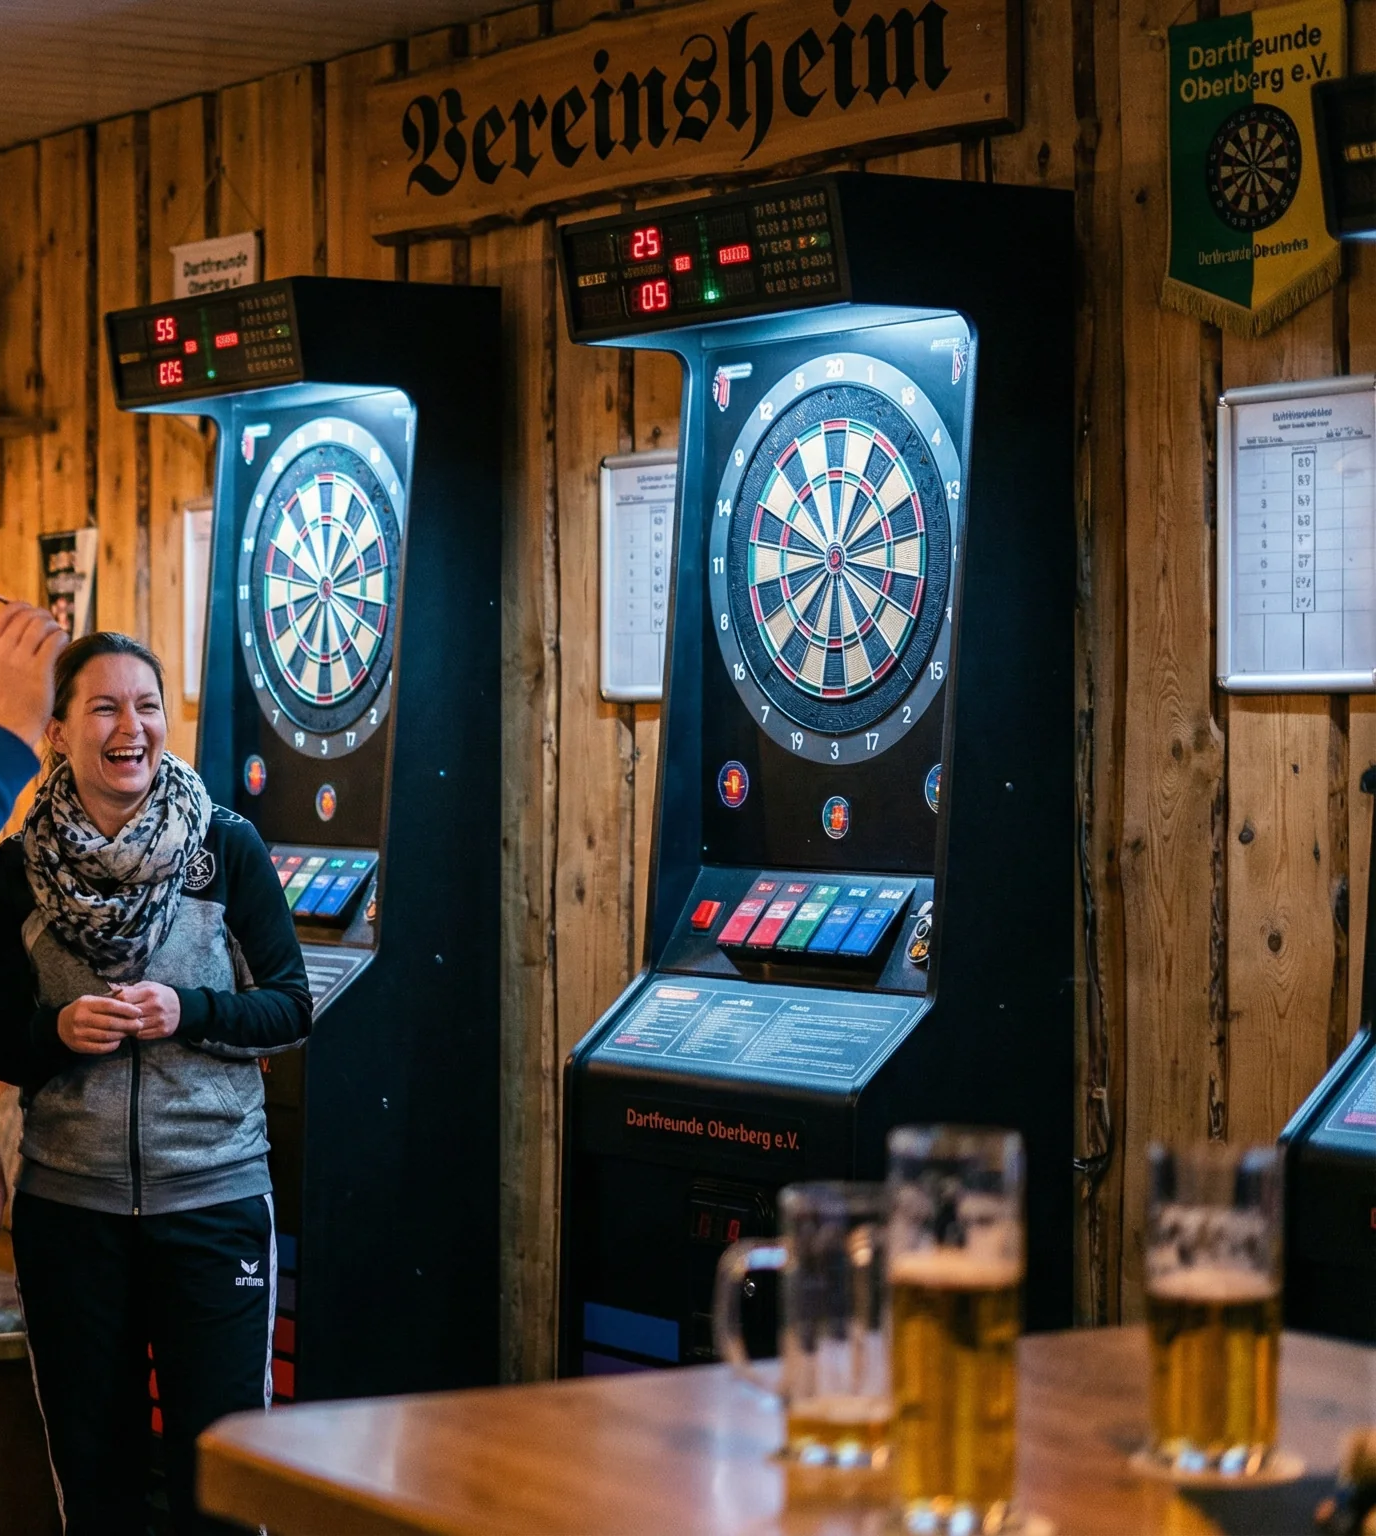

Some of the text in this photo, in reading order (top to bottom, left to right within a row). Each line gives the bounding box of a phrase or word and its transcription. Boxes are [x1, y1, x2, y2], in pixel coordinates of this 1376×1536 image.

[1187, 23, 1321, 71] Dartfreunde
[1180, 52, 1332, 102] Oberberg e.V.
[401, 0, 951, 196] Vereinsheim
[633, 229, 659, 258] 25
[184, 250, 247, 277] Dartfreunde
[642, 281, 667, 310] 05
[826, 359, 844, 378] 20
[867, 364, 874, 383] 1
[795, 374, 805, 390] 5
[759, 402, 773, 421] 12
[931, 428, 941, 447] 4
[734, 449, 744, 467] 9
[946, 481, 960, 500] 13
[717, 499, 731, 517] 14
[713, 557, 724, 574] 11
[720, 613, 729, 631] 8
[733, 663, 746, 681] 16
[930, 661, 943, 680] 15
[272, 709, 280, 725] 7
[370, 708, 377, 724] 2
[761, 705, 770, 724] 7
[903, 706, 911, 724] 2
[321, 739, 328, 755] 3
[345, 731, 356, 746] 17
[791, 732, 803, 750] 19
[865, 732, 879, 751] 17
[830, 742, 839, 760] 3
[627, 1108, 704, 1135] Dartfreunde
[707, 1120, 800, 1150] Oberberg e.V.
